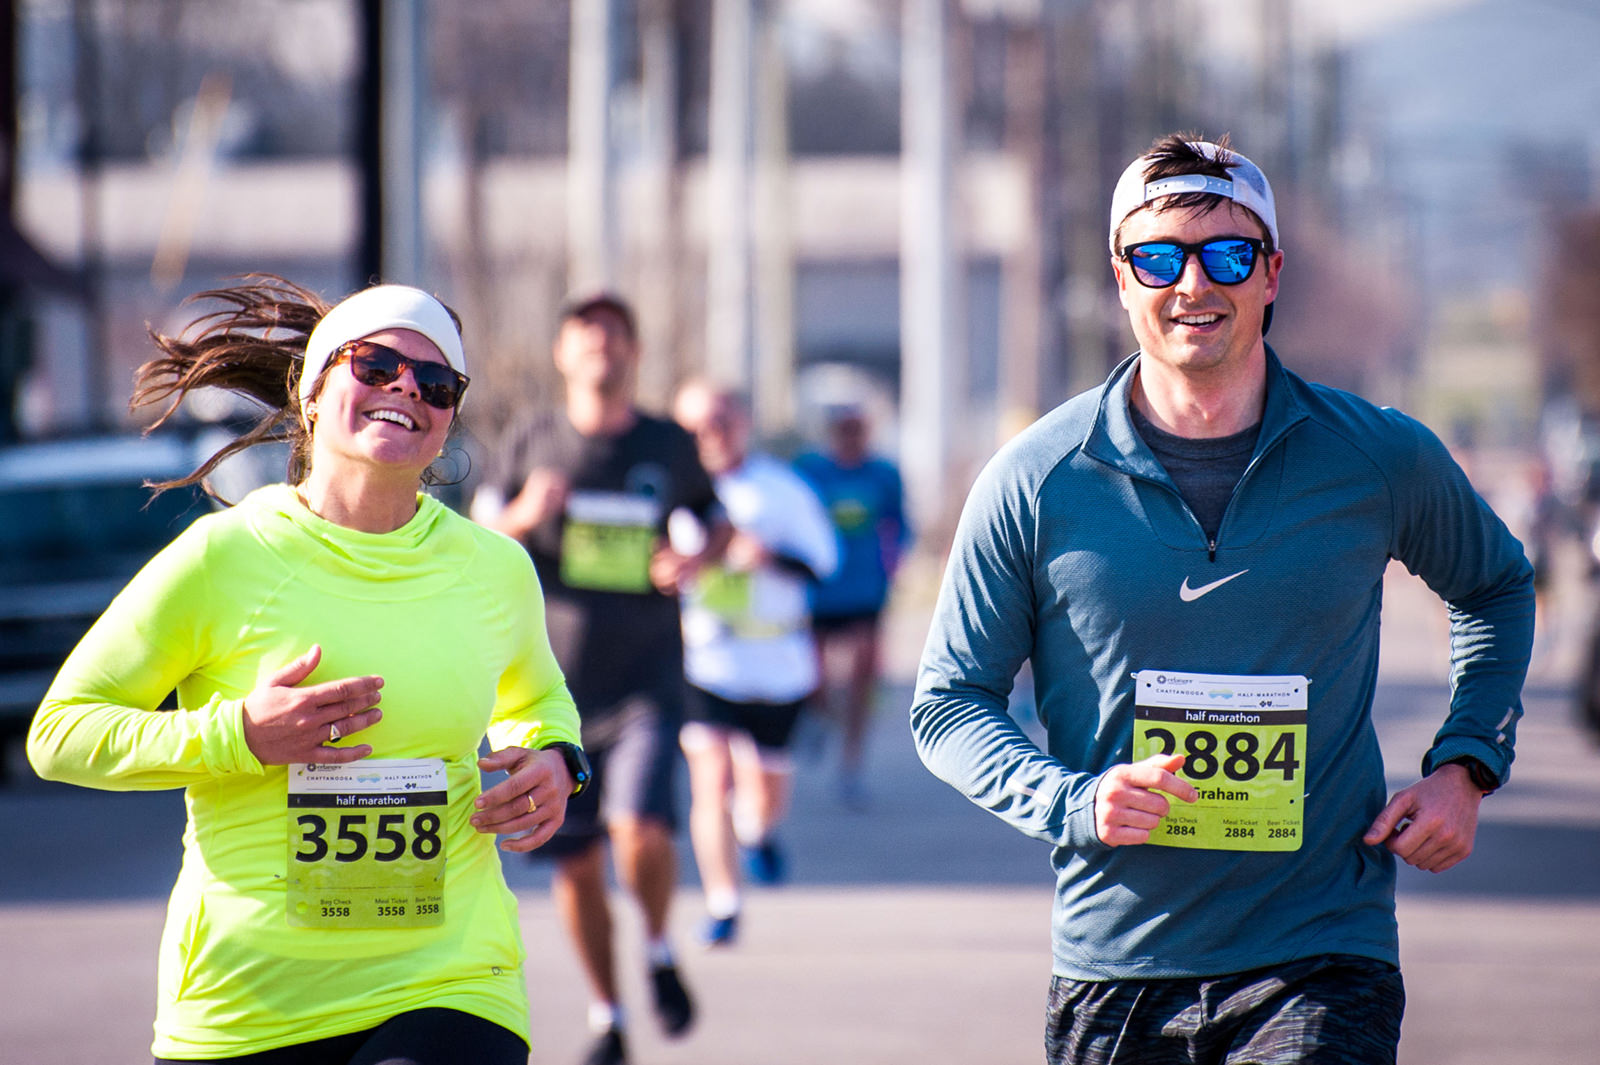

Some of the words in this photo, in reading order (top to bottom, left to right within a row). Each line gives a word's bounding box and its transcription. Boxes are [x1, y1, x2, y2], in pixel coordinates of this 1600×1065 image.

[1156, 688, 1204, 696] CHATTANOOGA
[1185, 710, 1206, 721] half
[1208, 712, 1260, 723] marathon
[336, 796, 355, 806] half
[358, 796, 406, 806] marathon
[1166, 824, 1195, 835] 2884
[1225, 828, 1254, 838] 2884
[1268, 828, 1296, 838] 2884
[295, 812, 442, 863] 3558
[321, 907, 350, 917] 3558
[377, 906, 405, 916] 3558
[416, 904, 439, 915] 3558
